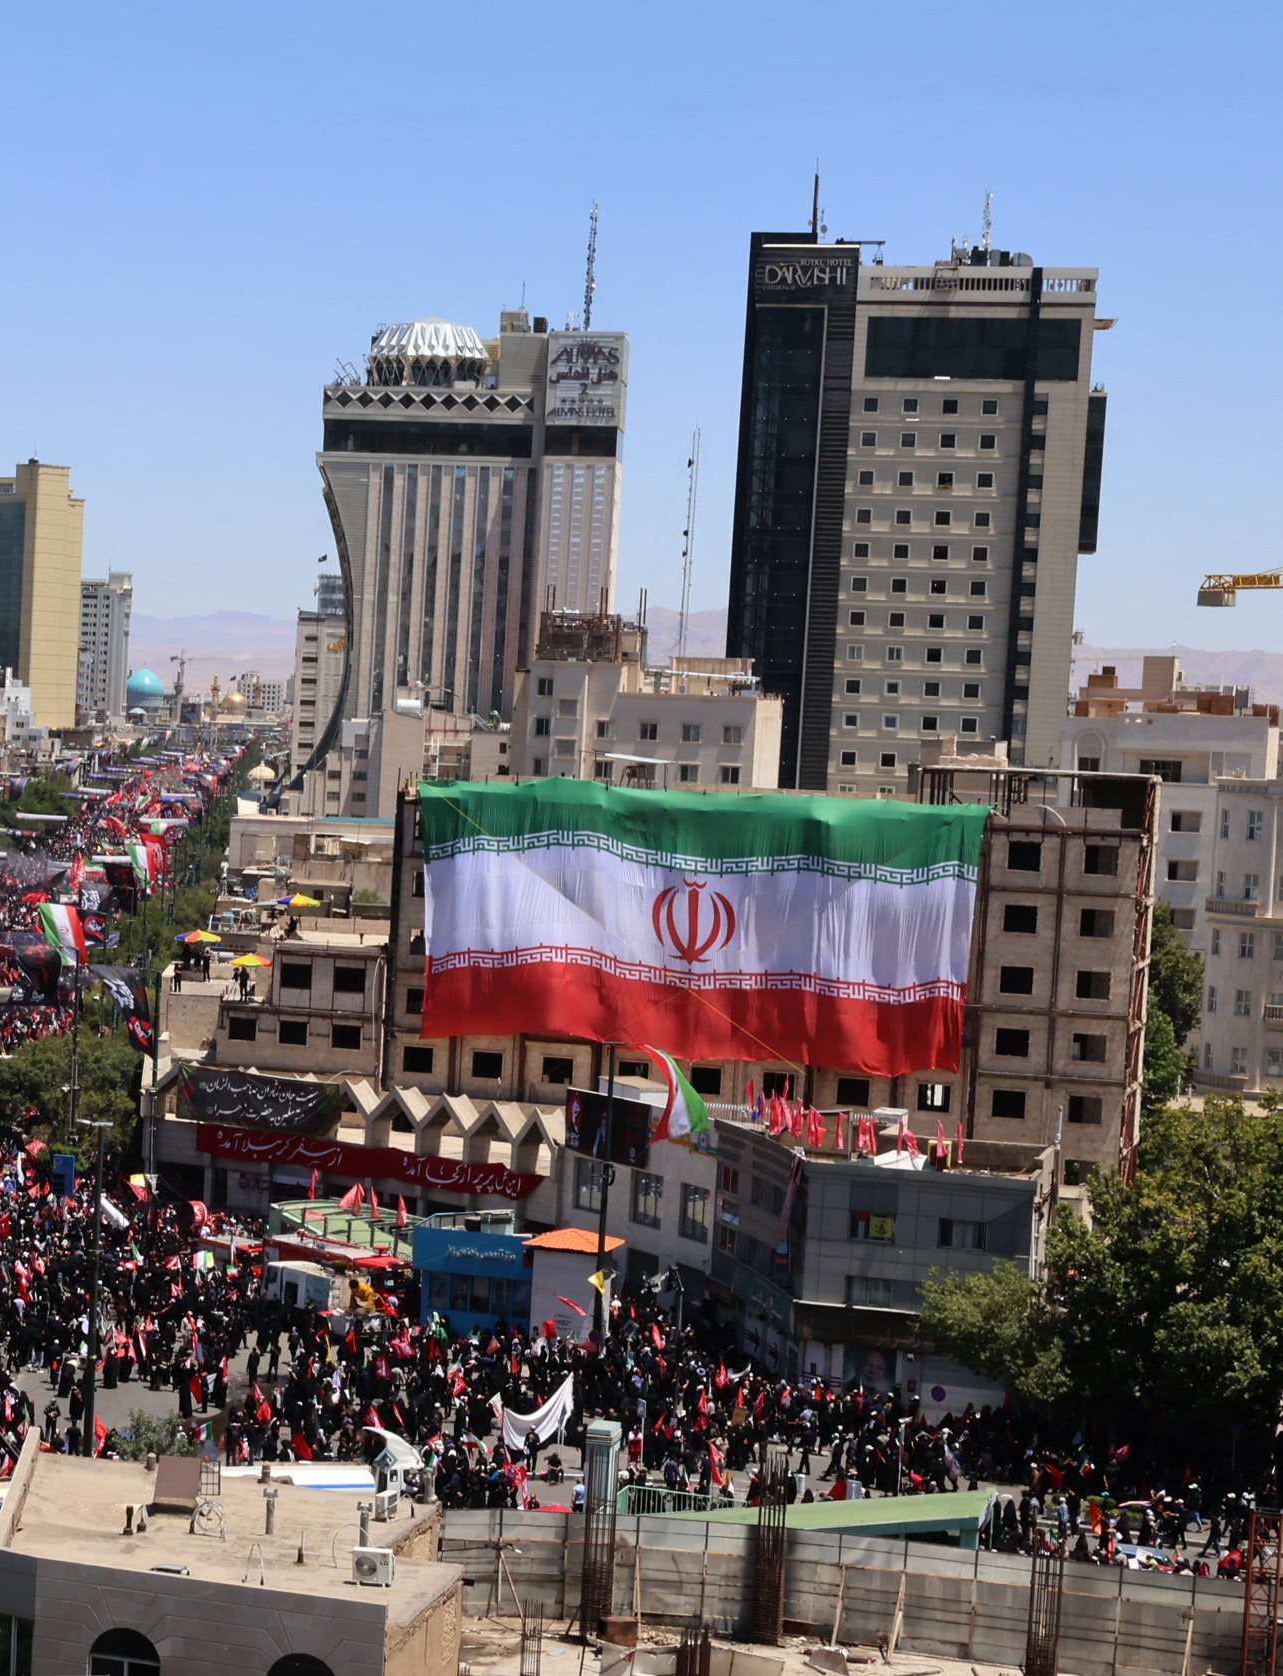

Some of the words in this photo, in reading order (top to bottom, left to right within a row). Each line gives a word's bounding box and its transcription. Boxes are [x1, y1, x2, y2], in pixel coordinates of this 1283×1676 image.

[800, 258, 823, 267] ROYAL
[826, 258, 852, 267] HOTEL
[765, 262, 846, 288] DARVISHI
[550, 347, 620, 365] ALMAS
[549, 365, 590, 384] الماس
[591, 365, 618, 385] هتل
[579, 382, 589, 396] 2
[546, 406, 584, 417] ALMAS
[585, 406, 616, 417] HOTEL
